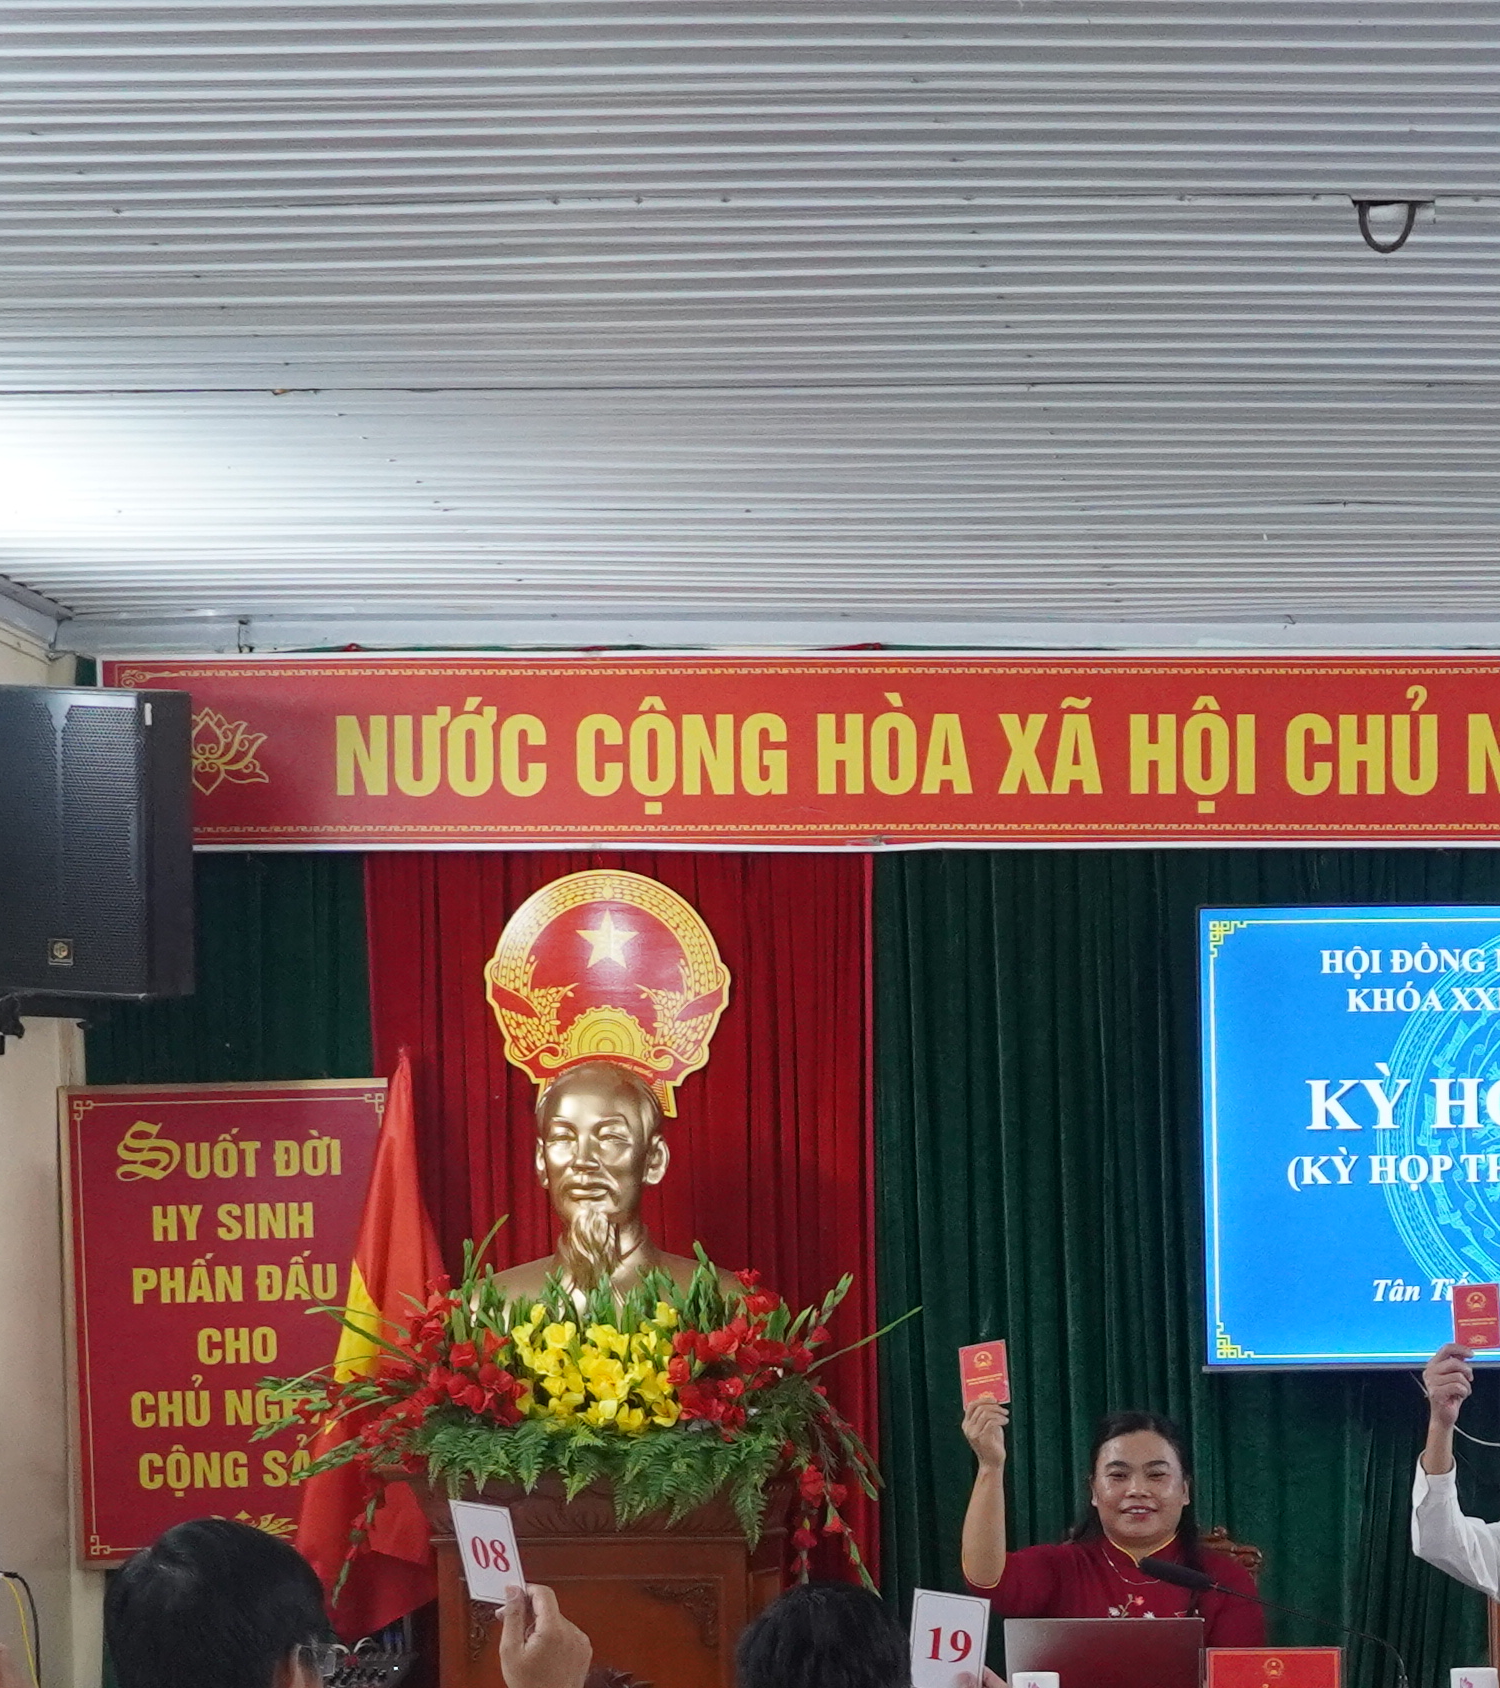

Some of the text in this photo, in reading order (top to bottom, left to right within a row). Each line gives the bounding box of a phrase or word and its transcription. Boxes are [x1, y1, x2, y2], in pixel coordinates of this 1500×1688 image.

[336, 696, 548, 798] NƯỚC
[576, 696, 790, 816] CỘNG
[816, 692, 974, 797] HÒA
[998, 697, 1104, 797] XÃ
[1130, 696, 1257, 815] HỘI
[1286, 688, 1440, 797] CHỦ
[1320, 945, 1382, 981] HỘI
[1390, 942, 1487, 974] ĐỒNG
[1346, 981, 1445, 1013] KHÓA
[1305, 1062, 1411, 1130] KỲ
[116, 1120, 342, 1182] SUỐT ĐỜI
[1287, 1146, 1359, 1192] (KỲ
[1368, 1154, 1453, 1192] HỌP
[152, 1202, 315, 1243] HY SINH
[132, 1250, 339, 1305] PHẤN ĐẤU
[1372, 1278, 1421, 1302] Tân
[197, 1326, 279, 1366] CHO
[130, 1374, 212, 1429] CHỦ
[139, 1444, 250, 1498] CỘNG
[470, 1536, 511, 1573] 08
[926, 1626, 973, 1663] 19
